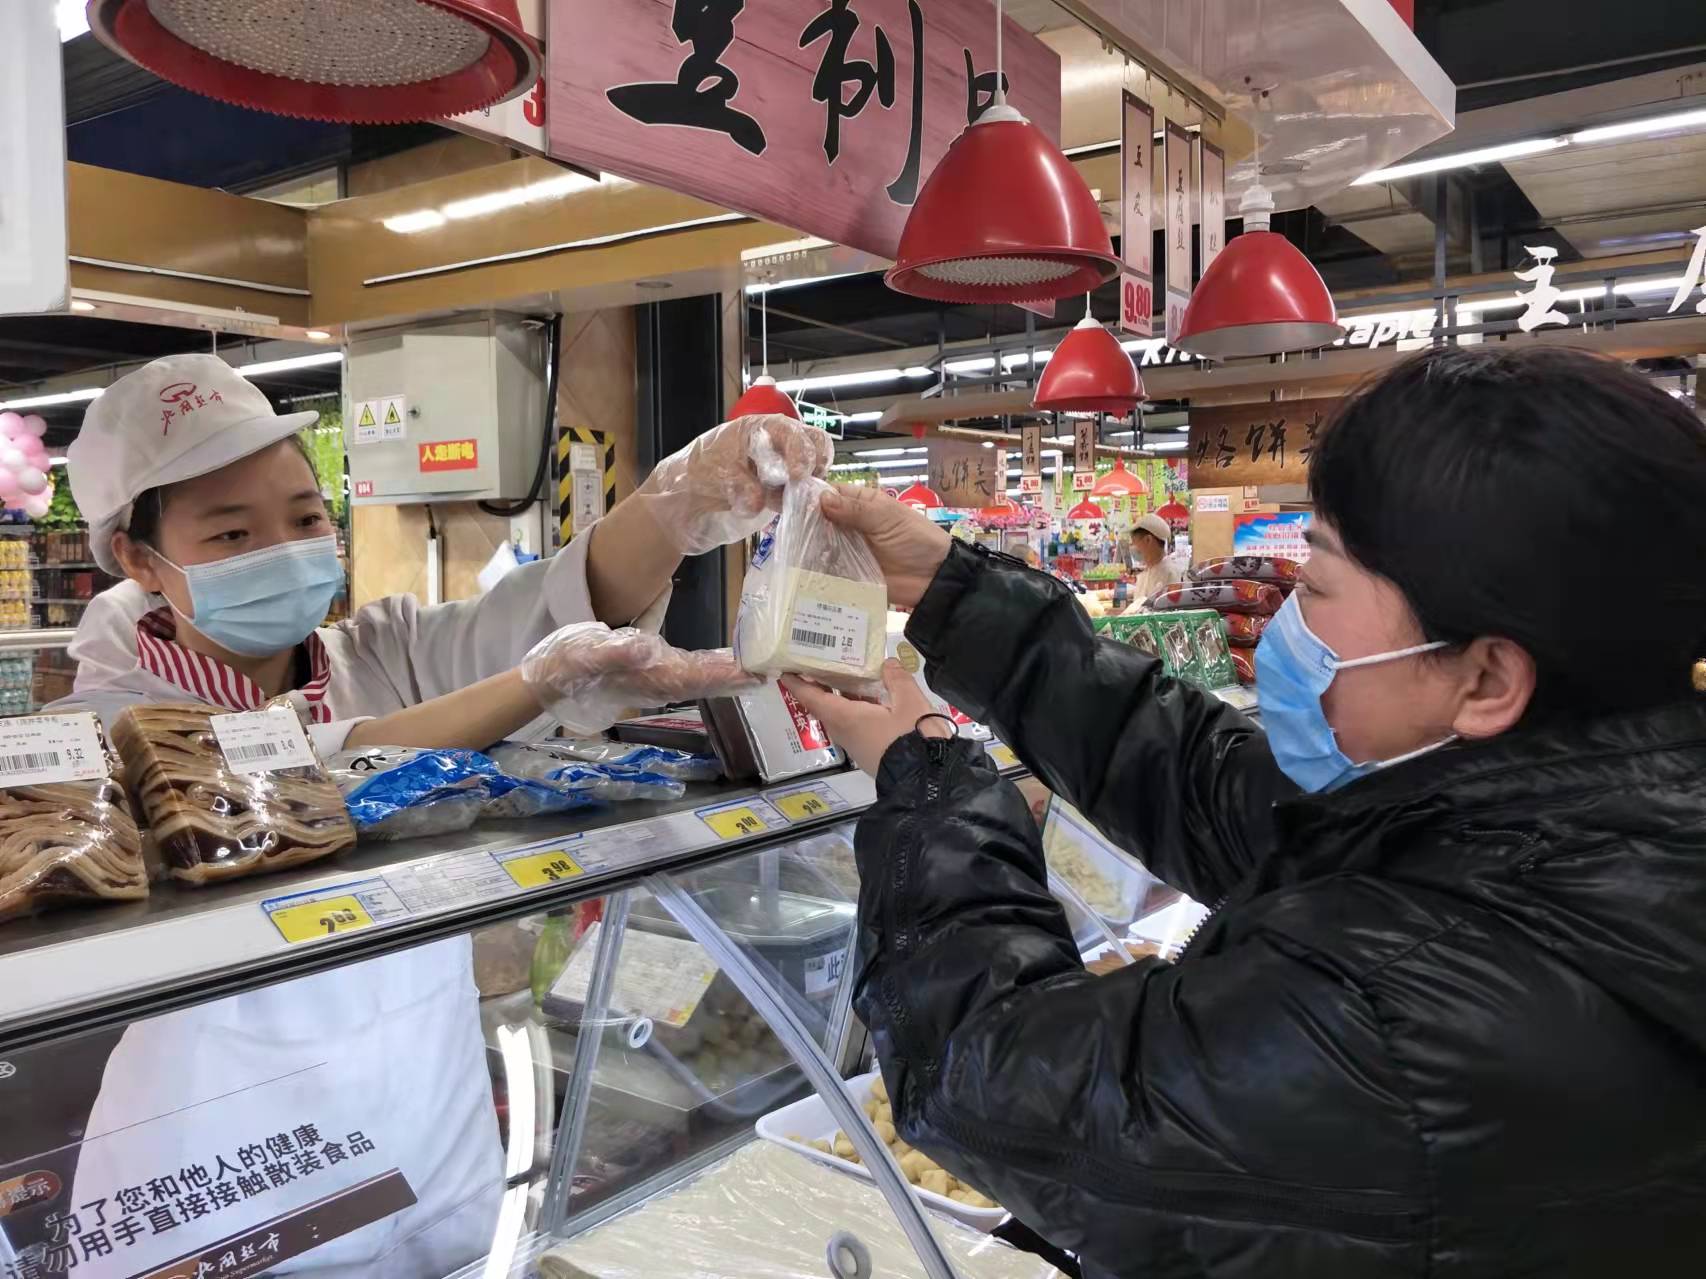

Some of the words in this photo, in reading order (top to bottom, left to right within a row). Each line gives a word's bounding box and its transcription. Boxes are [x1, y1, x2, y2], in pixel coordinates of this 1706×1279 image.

[1124, 281, 1151, 324] 9.80
[4, 1130, 376, 1279] 请勿用手直接接触散装食品
[44, 1122, 324, 1243] 为了您和他人的健康
